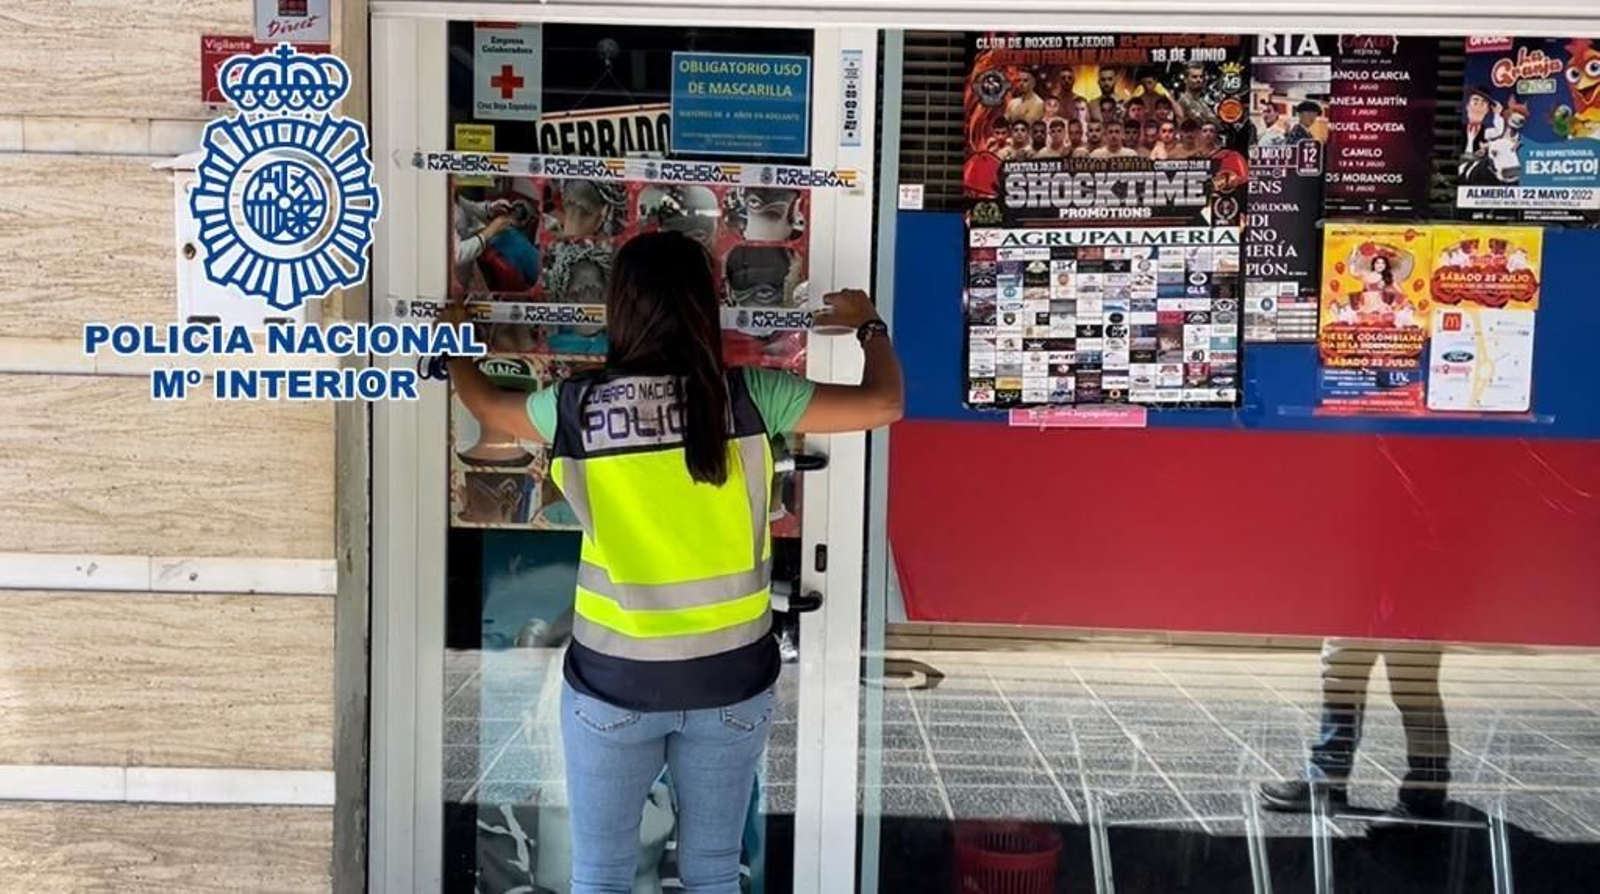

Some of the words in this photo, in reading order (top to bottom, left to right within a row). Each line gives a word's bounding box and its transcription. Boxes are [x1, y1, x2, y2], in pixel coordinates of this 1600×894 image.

[204, 39, 251, 51] Vigilante
[491, 36, 524, 46] Empresa
[976, 38, 1005, 49] CLUB
[1008, 37, 1022, 49] DE
[1025, 37, 1062, 49] BOXEO
[1065, 36, 1115, 48] TEJEDOR
[482, 45, 533, 54] Colaboradora
[1151, 49, 1166, 62] 18
[1170, 49, 1186, 62] DE
[1191, 48, 1227, 62] JUNIO
[679, 60, 771, 75] OBLIGATORIO
[774, 64, 802, 76] USO
[688, 81, 706, 95] DE
[708, 83, 793, 97] MASCARILLA
[1366, 95, 1408, 106] MARTÍN
[1363, 123, 1405, 132] POVEDA
[540, 112, 670, 157] CERRADO
[1303, 148, 1318, 163] 12
[1341, 147, 1383, 157] CAMILO
[427, 153, 490, 164] POLICIA
[544, 157, 607, 169] POLICIA
[427, 162, 509, 173] NACIONAL
[543, 167, 625, 178] NACIONAL
[660, 162, 723, 174] POLICIA
[776, 167, 838, 179] POLICIA
[1525, 158, 1599, 176] ¡EXACTO!
[660, 171, 741, 183] NACIONAL
[775, 176, 856, 188] NACIONAL
[1342, 173, 1403, 183] MORANCOS
[1004, 171, 1208, 208] SHOCKTIME
[1466, 187, 1516, 199] ALMERÍA
[1521, 189, 1535, 199] 22
[1538, 189, 1569, 199] MAYO
[1571, 190, 1594, 200] 2022
[1058, 207, 1151, 219] PROMOTIONS
[1246, 228, 1277, 242] NO
[525, 305, 586, 316] POLICIA
[752, 310, 813, 320] POLICIA
[524, 314, 603, 324] NACIONAL
[751, 318, 814, 328] NACION
[638, 380, 677, 400] NACIO
[585, 402, 686, 443] POLIC
